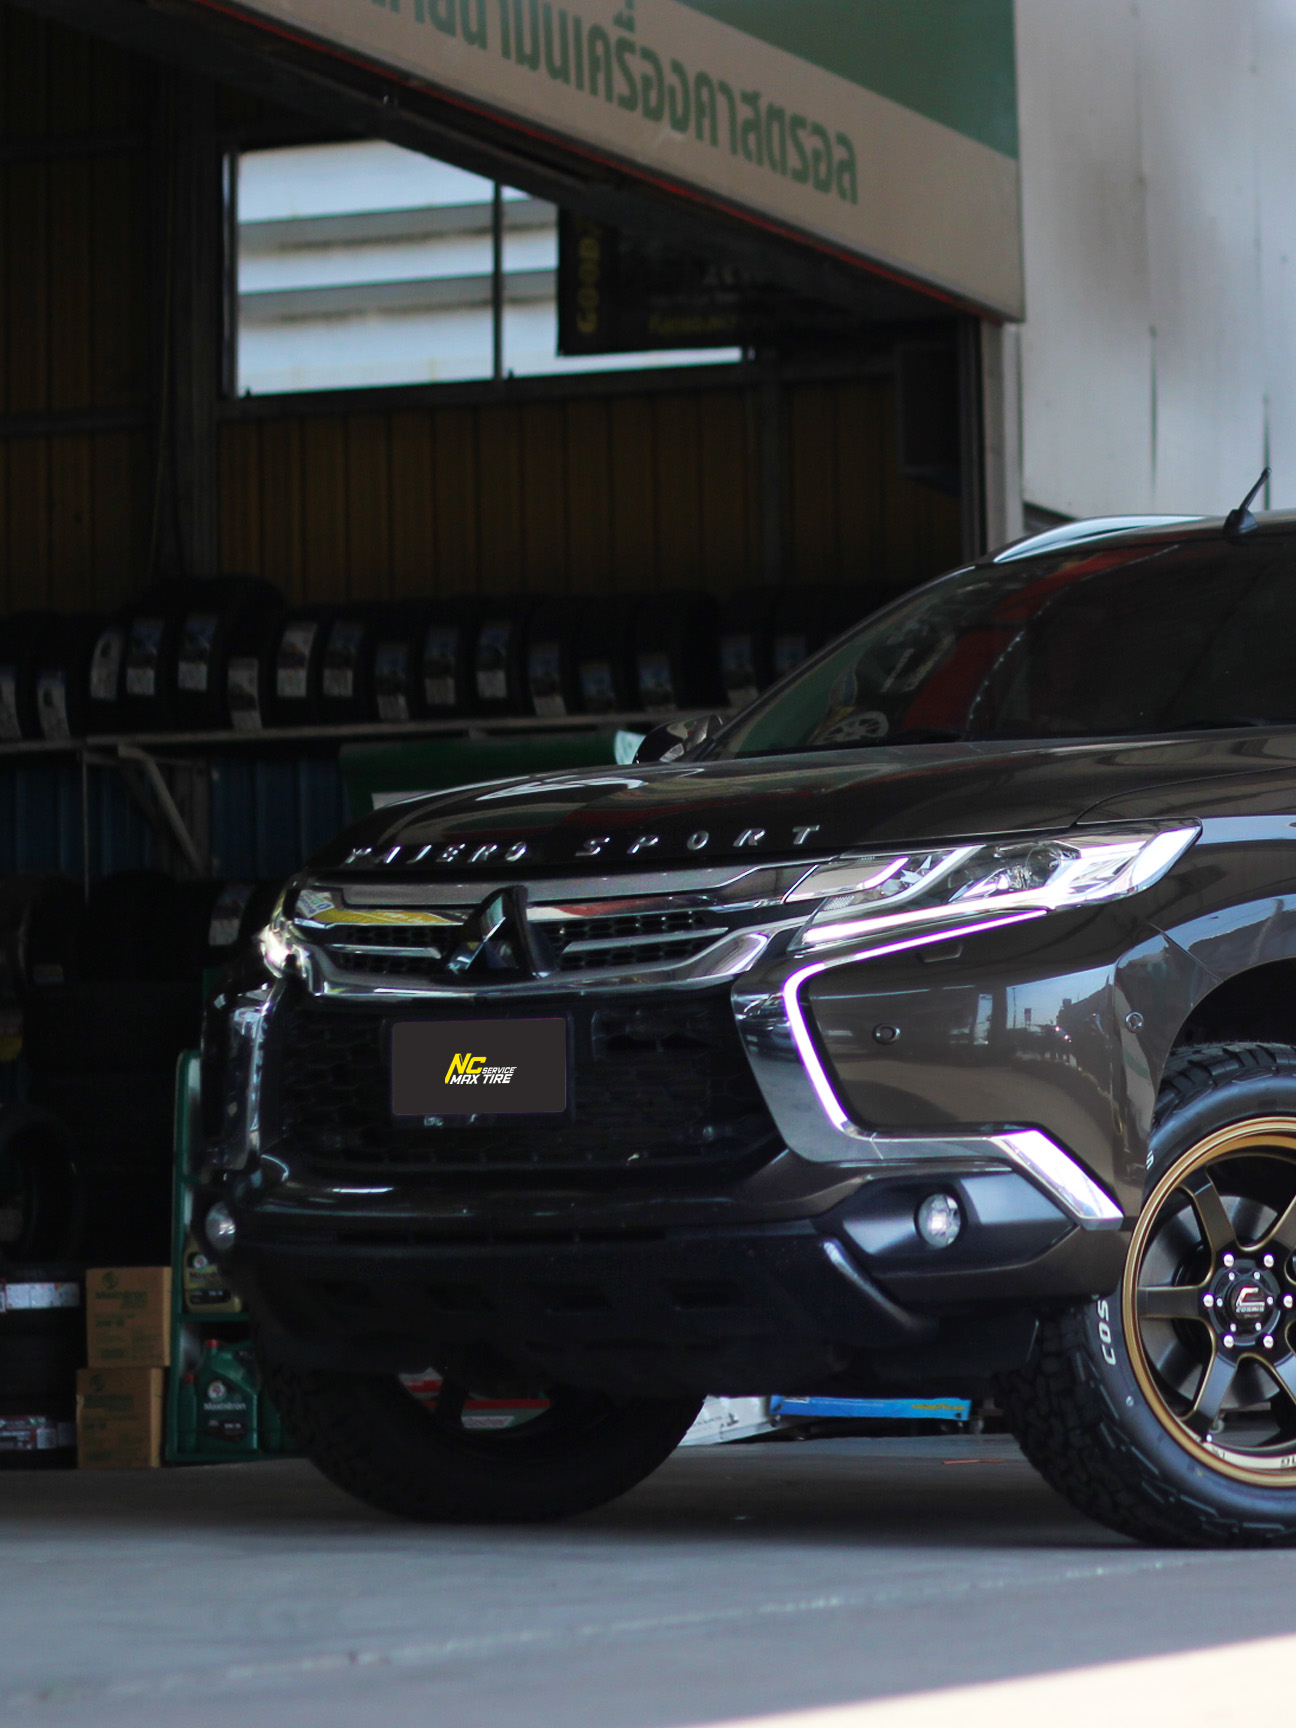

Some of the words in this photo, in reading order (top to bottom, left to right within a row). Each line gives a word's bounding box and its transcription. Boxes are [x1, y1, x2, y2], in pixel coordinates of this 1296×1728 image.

[344, 841, 528, 865] PAJERO
[575, 824, 821, 857] SPORT
[1095, 1296, 1117, 1366] COS
